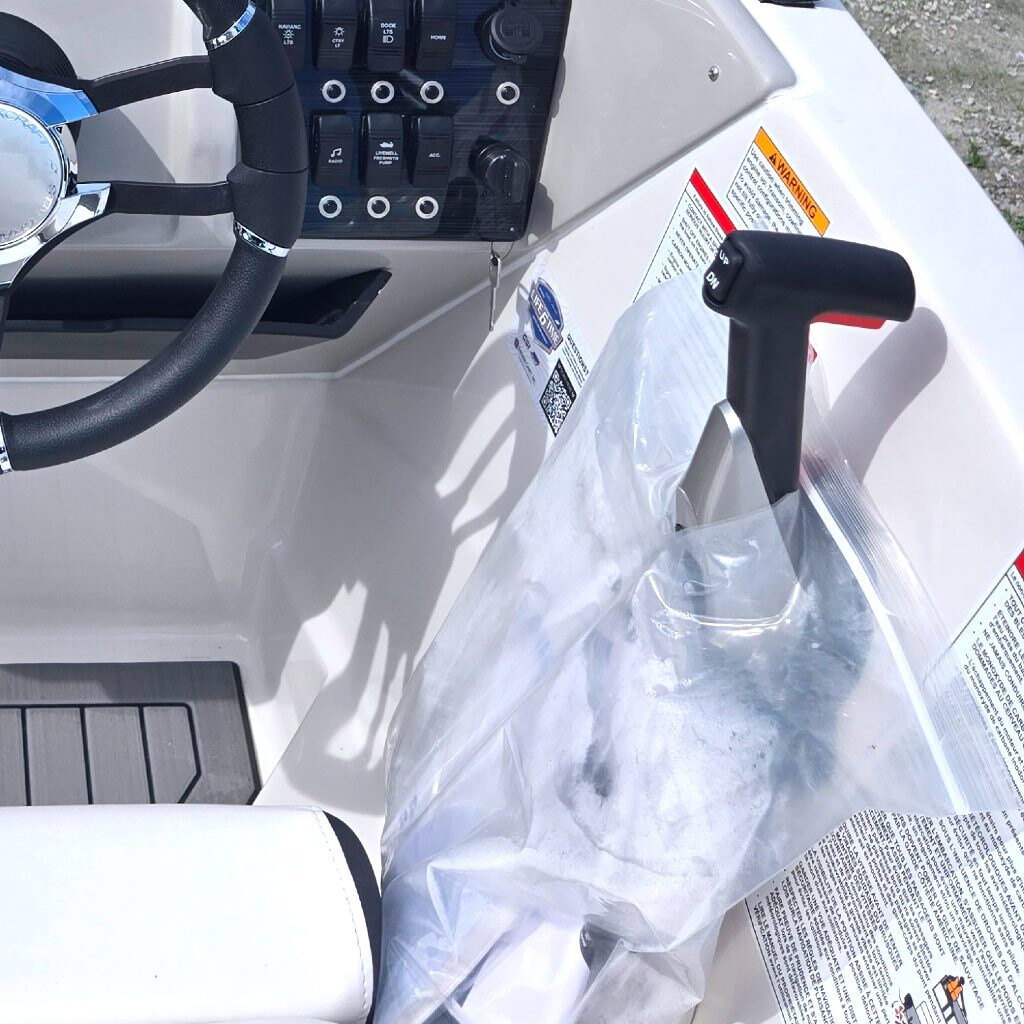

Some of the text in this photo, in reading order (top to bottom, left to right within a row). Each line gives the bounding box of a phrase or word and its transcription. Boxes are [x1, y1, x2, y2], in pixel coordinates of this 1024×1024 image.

[742, 165, 758, 186] control
[746, 157, 761, 177] engine
[750, 148, 803, 226] Use caution when trimming
[777, 160, 817, 218] WARNING
[706, 271, 720, 289] DN
[530, 289, 544, 314] LIFE
